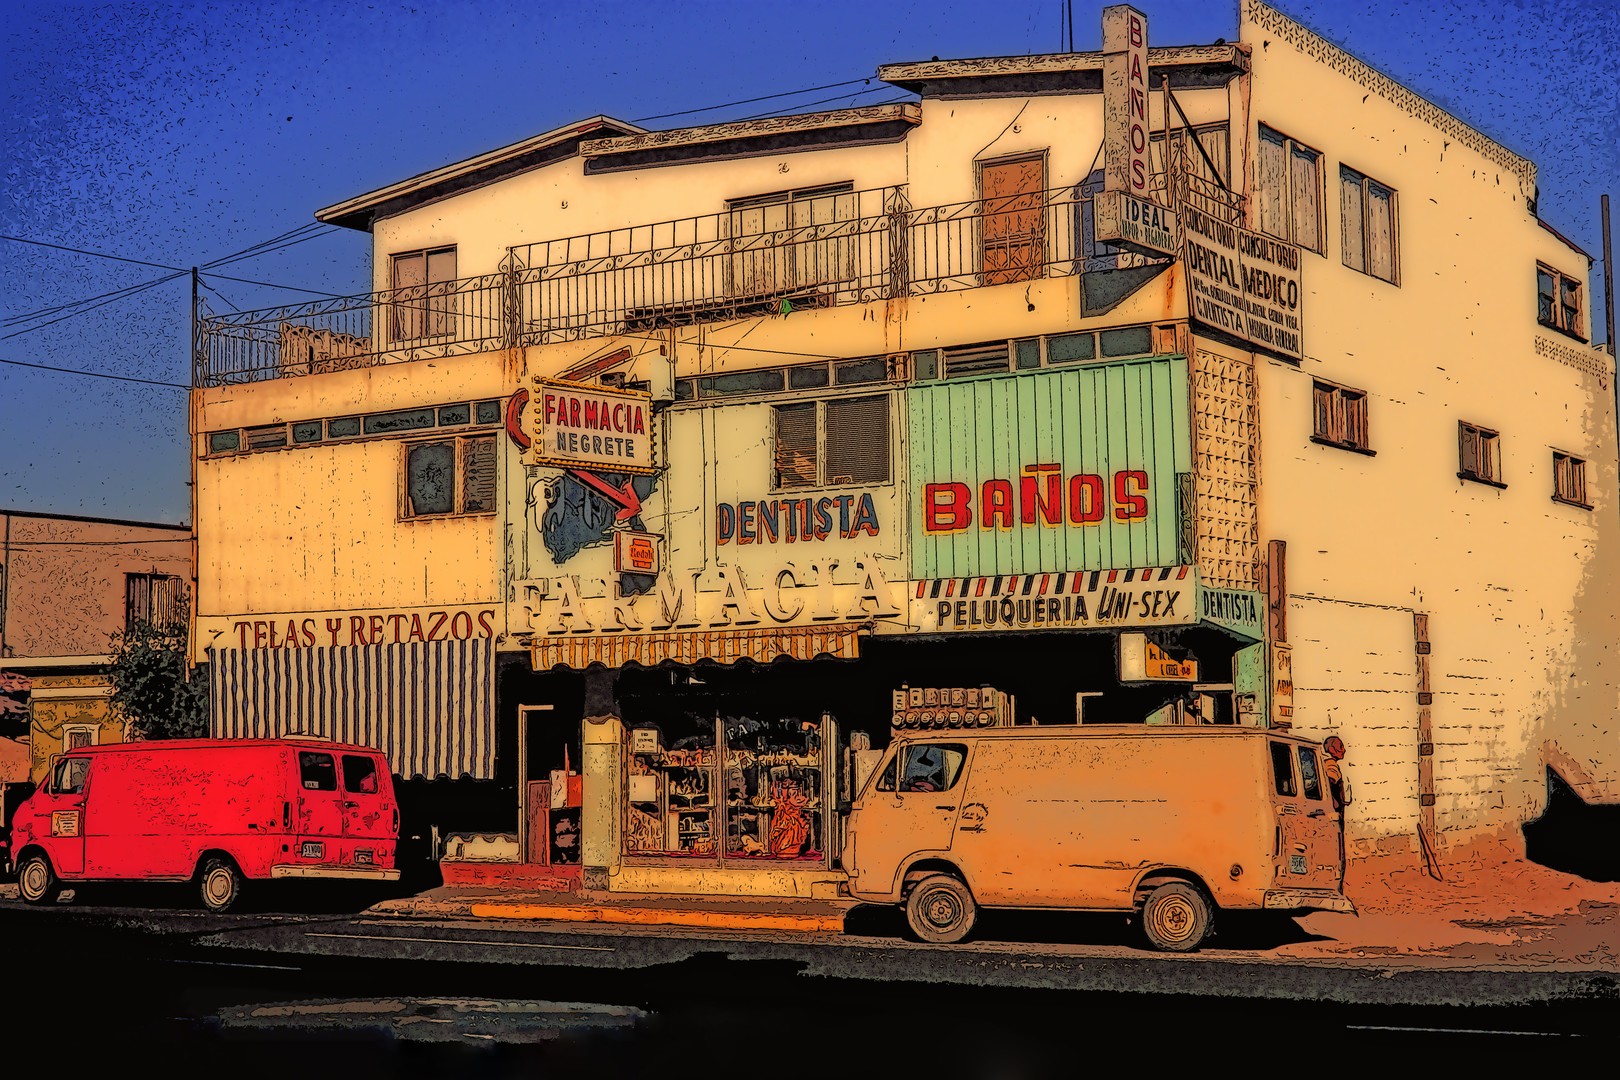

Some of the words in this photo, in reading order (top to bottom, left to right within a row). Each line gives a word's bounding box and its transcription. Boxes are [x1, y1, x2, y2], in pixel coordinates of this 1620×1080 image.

[1125, 196, 1170, 233] IDEAL
[1183, 205, 1236, 250] CONSULTORIO
[1188, 239, 1240, 289] DENTAL
[1240, 231, 1298, 271] CONSULTORIO
[1242, 264, 1298, 310] MEDICO
[545, 394, 645, 435] FARMACIA
[557, 431, 635, 459] NEGRETE
[716, 493, 880, 546] DENTISTA
[922, 463, 1149, 536] BAÑOS
[510, 557, 902, 636] FARMACIA
[1202, 590, 1258, 623] DENTISTA
[233, 617, 316, 650] TELAS
[326, 617, 342, 648] Y
[350, 609, 496, 646] RETAZOS
